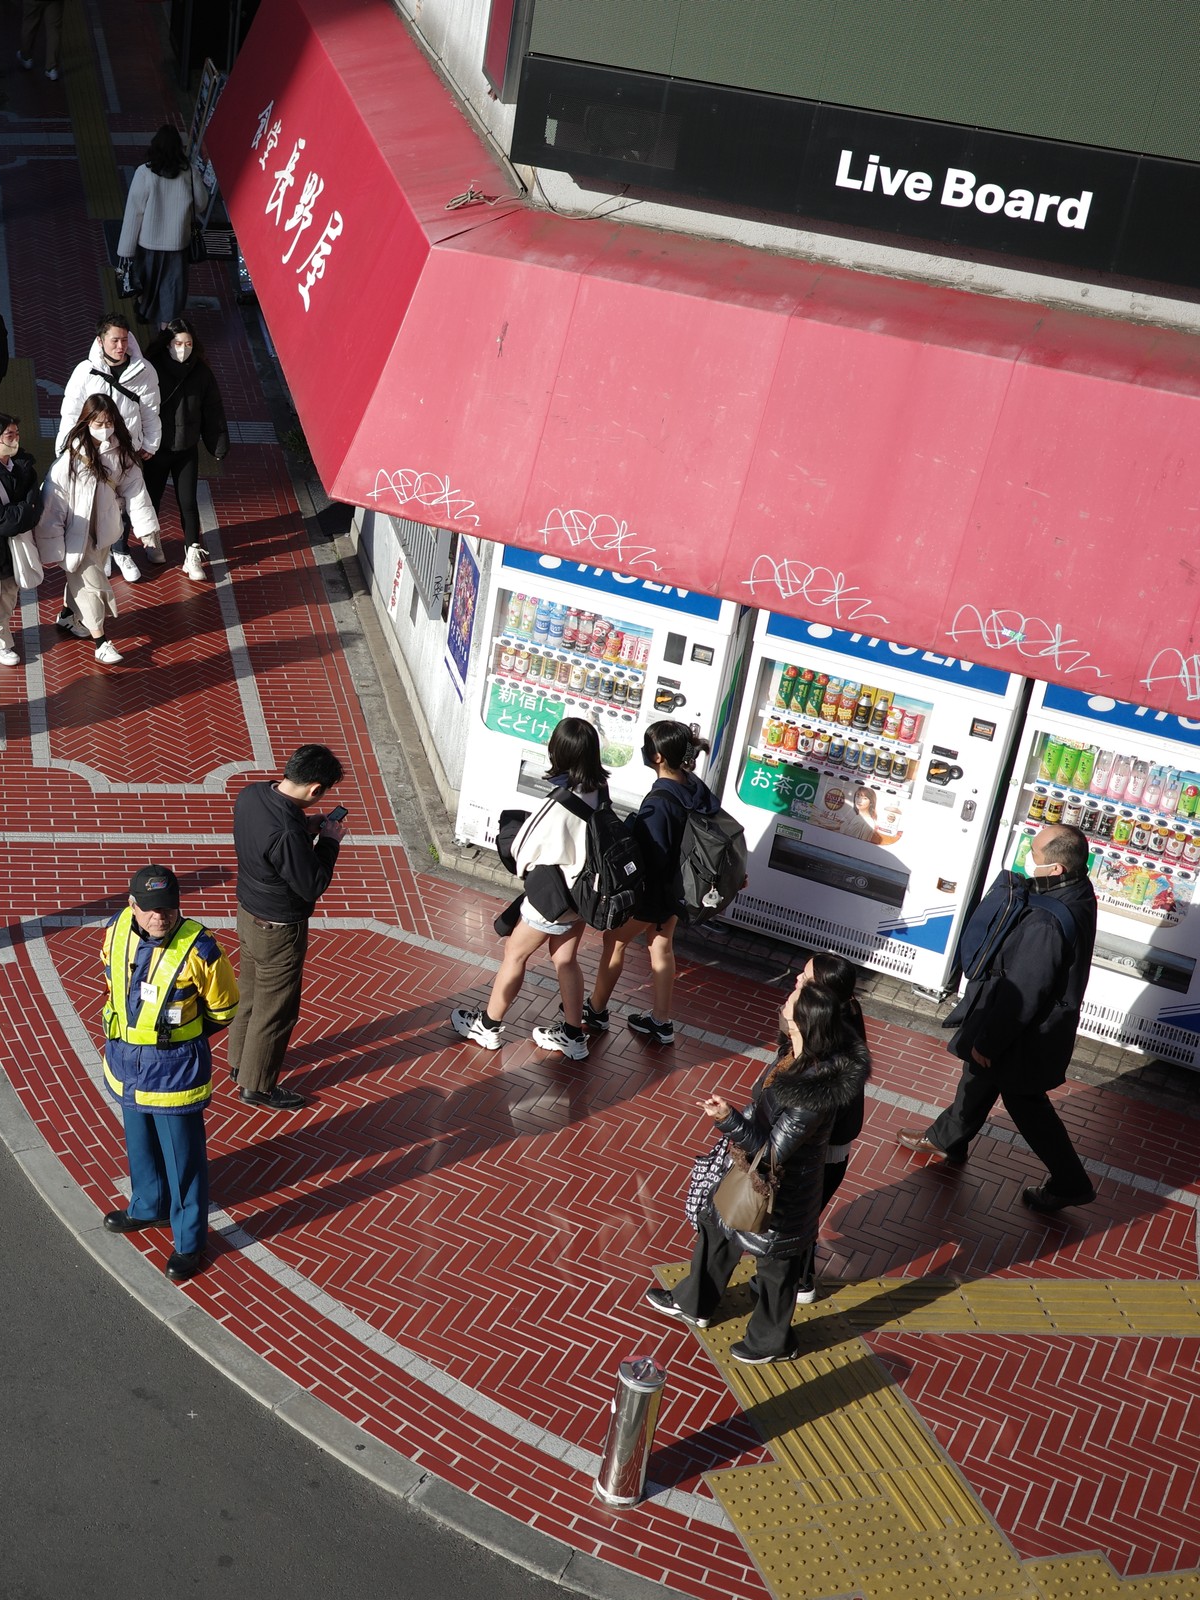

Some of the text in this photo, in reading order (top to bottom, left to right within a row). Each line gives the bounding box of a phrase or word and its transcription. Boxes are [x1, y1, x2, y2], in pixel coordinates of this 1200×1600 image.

[835, 149, 1094, 230] Live Board
[498, 686, 557, 714] 新宿に
[750, 767, 815, 800] お茶の
[1106, 896, 1142, 911] Japanese
